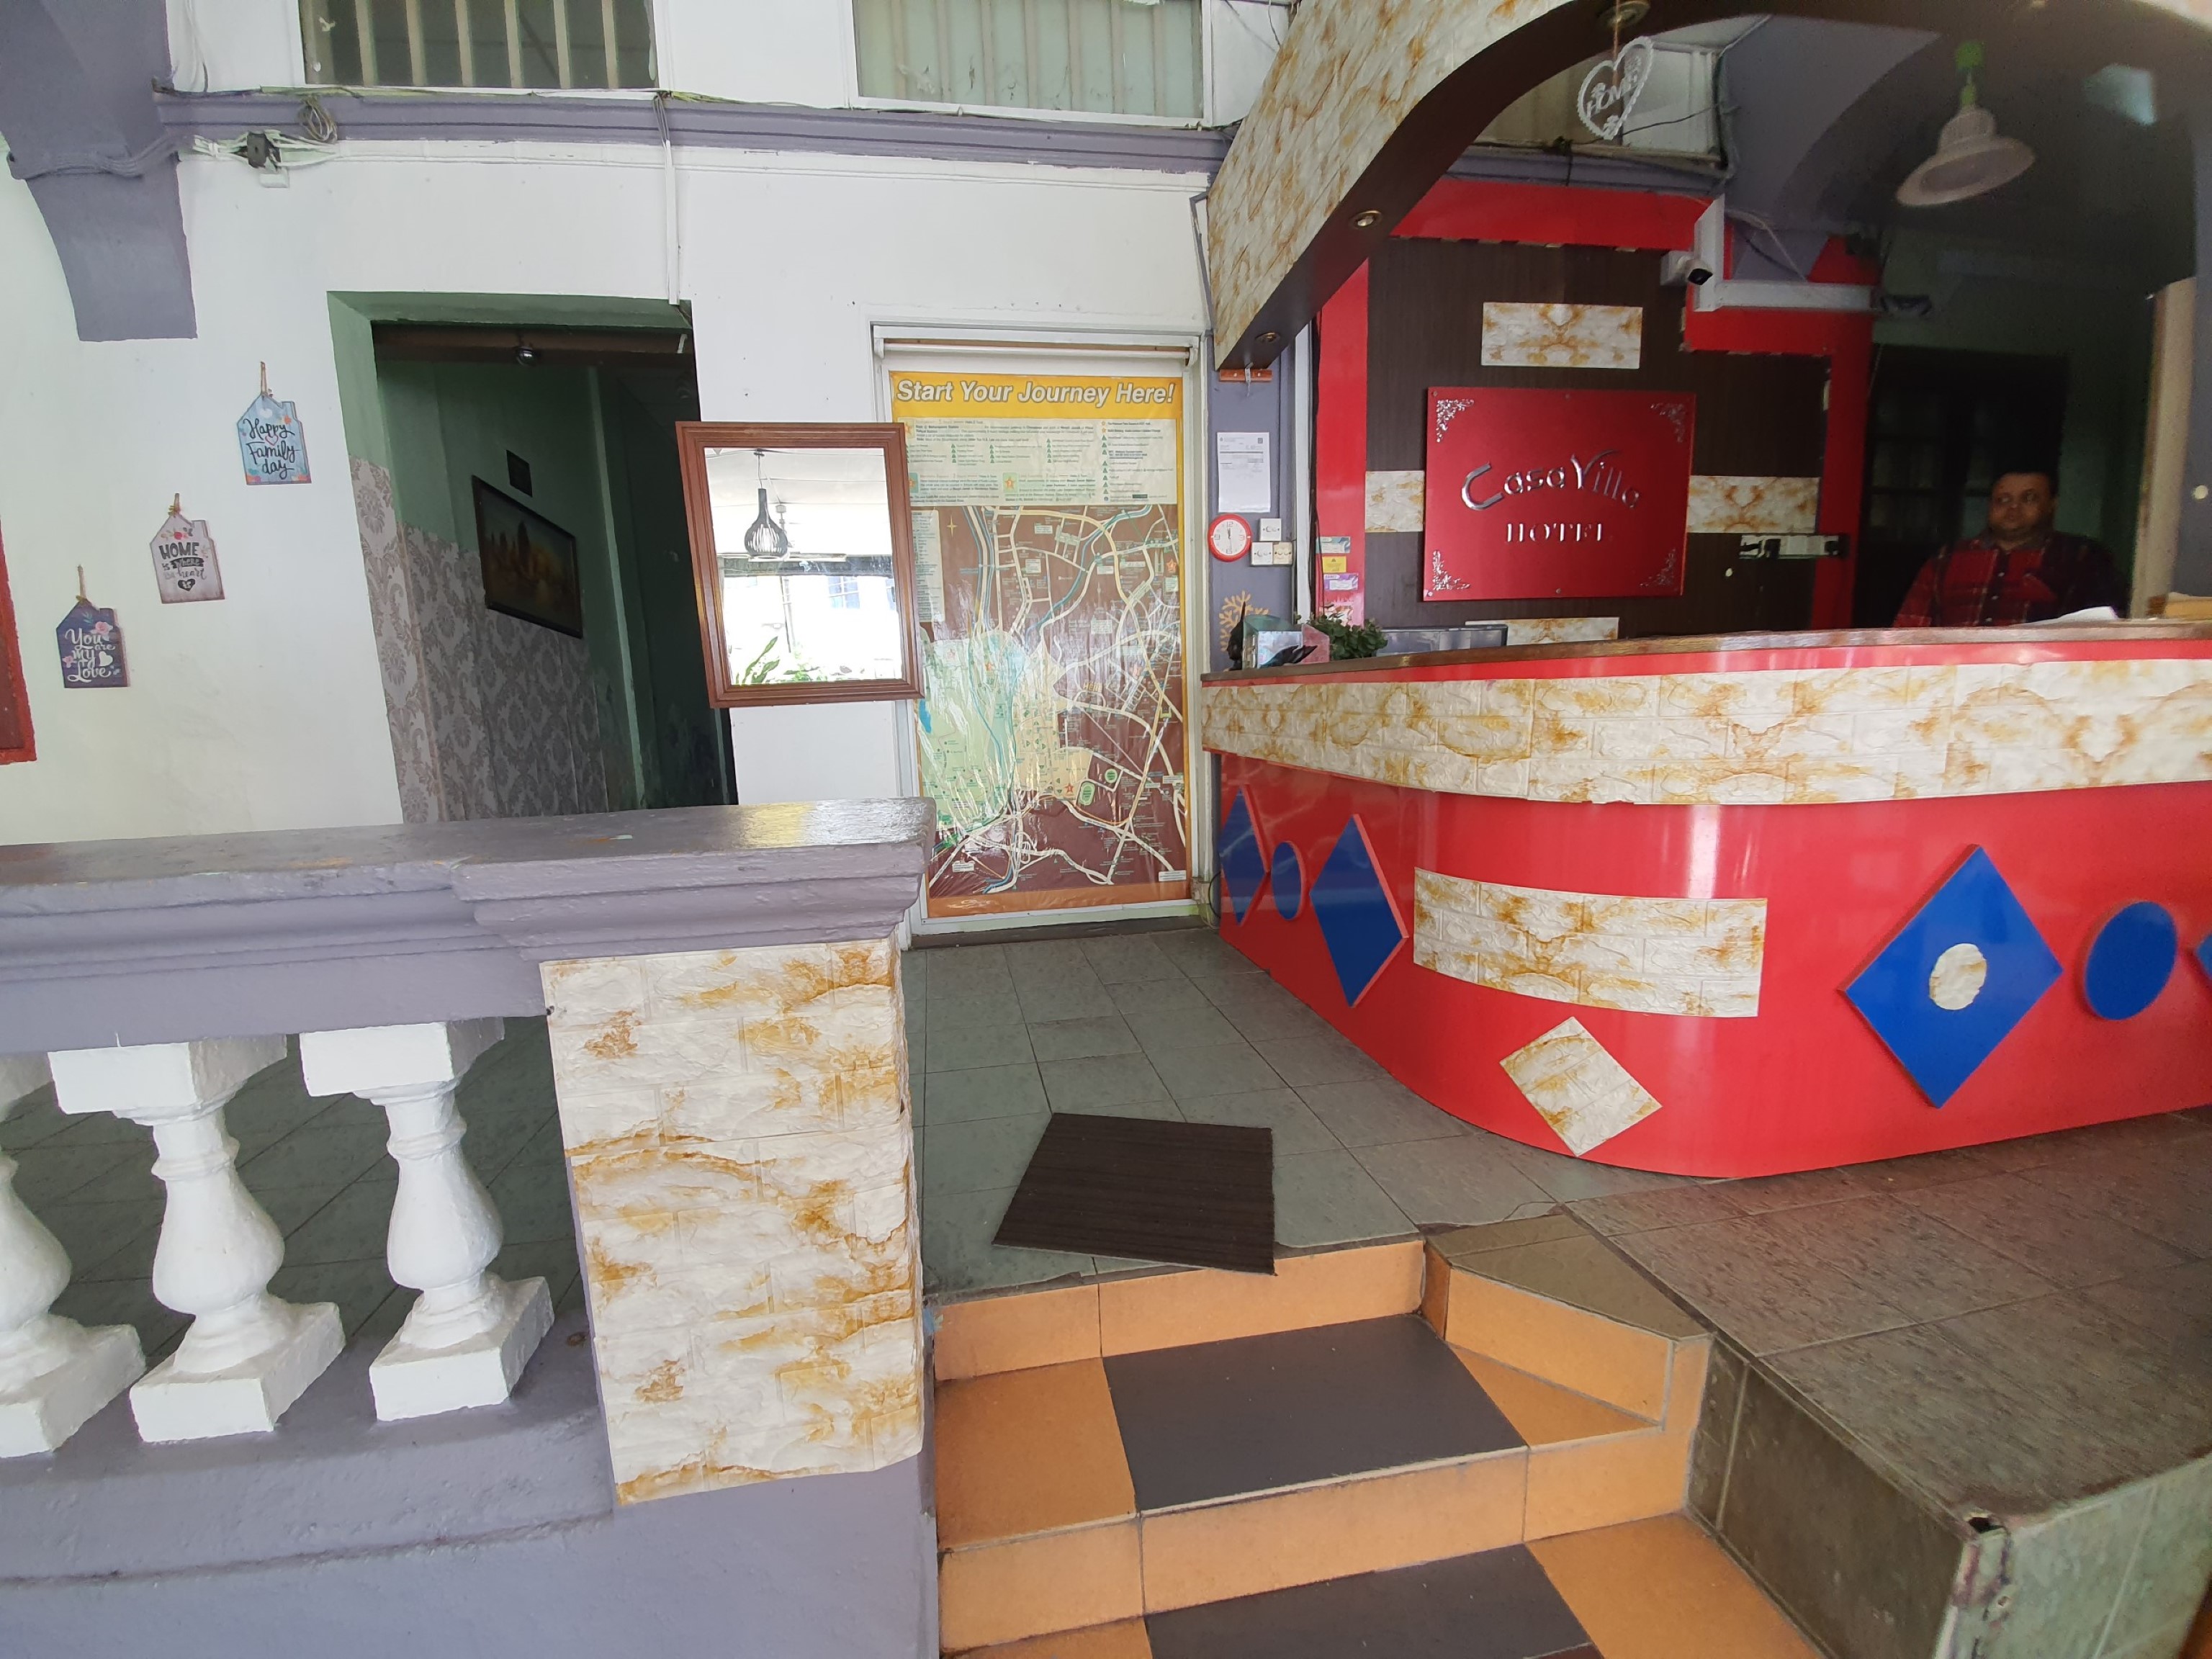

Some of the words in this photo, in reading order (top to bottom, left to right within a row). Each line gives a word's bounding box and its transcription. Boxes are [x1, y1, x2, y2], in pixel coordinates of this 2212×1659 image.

[897, 379, 954, 402] Start
[961, 380, 1013, 403] Your
[1017, 381, 1112, 408] Journey
[1115, 382, 1176, 404] Here!
[243, 418, 295, 441] Happy
[246, 440, 301, 465] Family
[261, 458, 295, 480] day
[158, 541, 200, 559] HOME
[65, 627, 103, 650] You
[71, 649, 96, 669] my
[67, 660, 112, 683] Love
